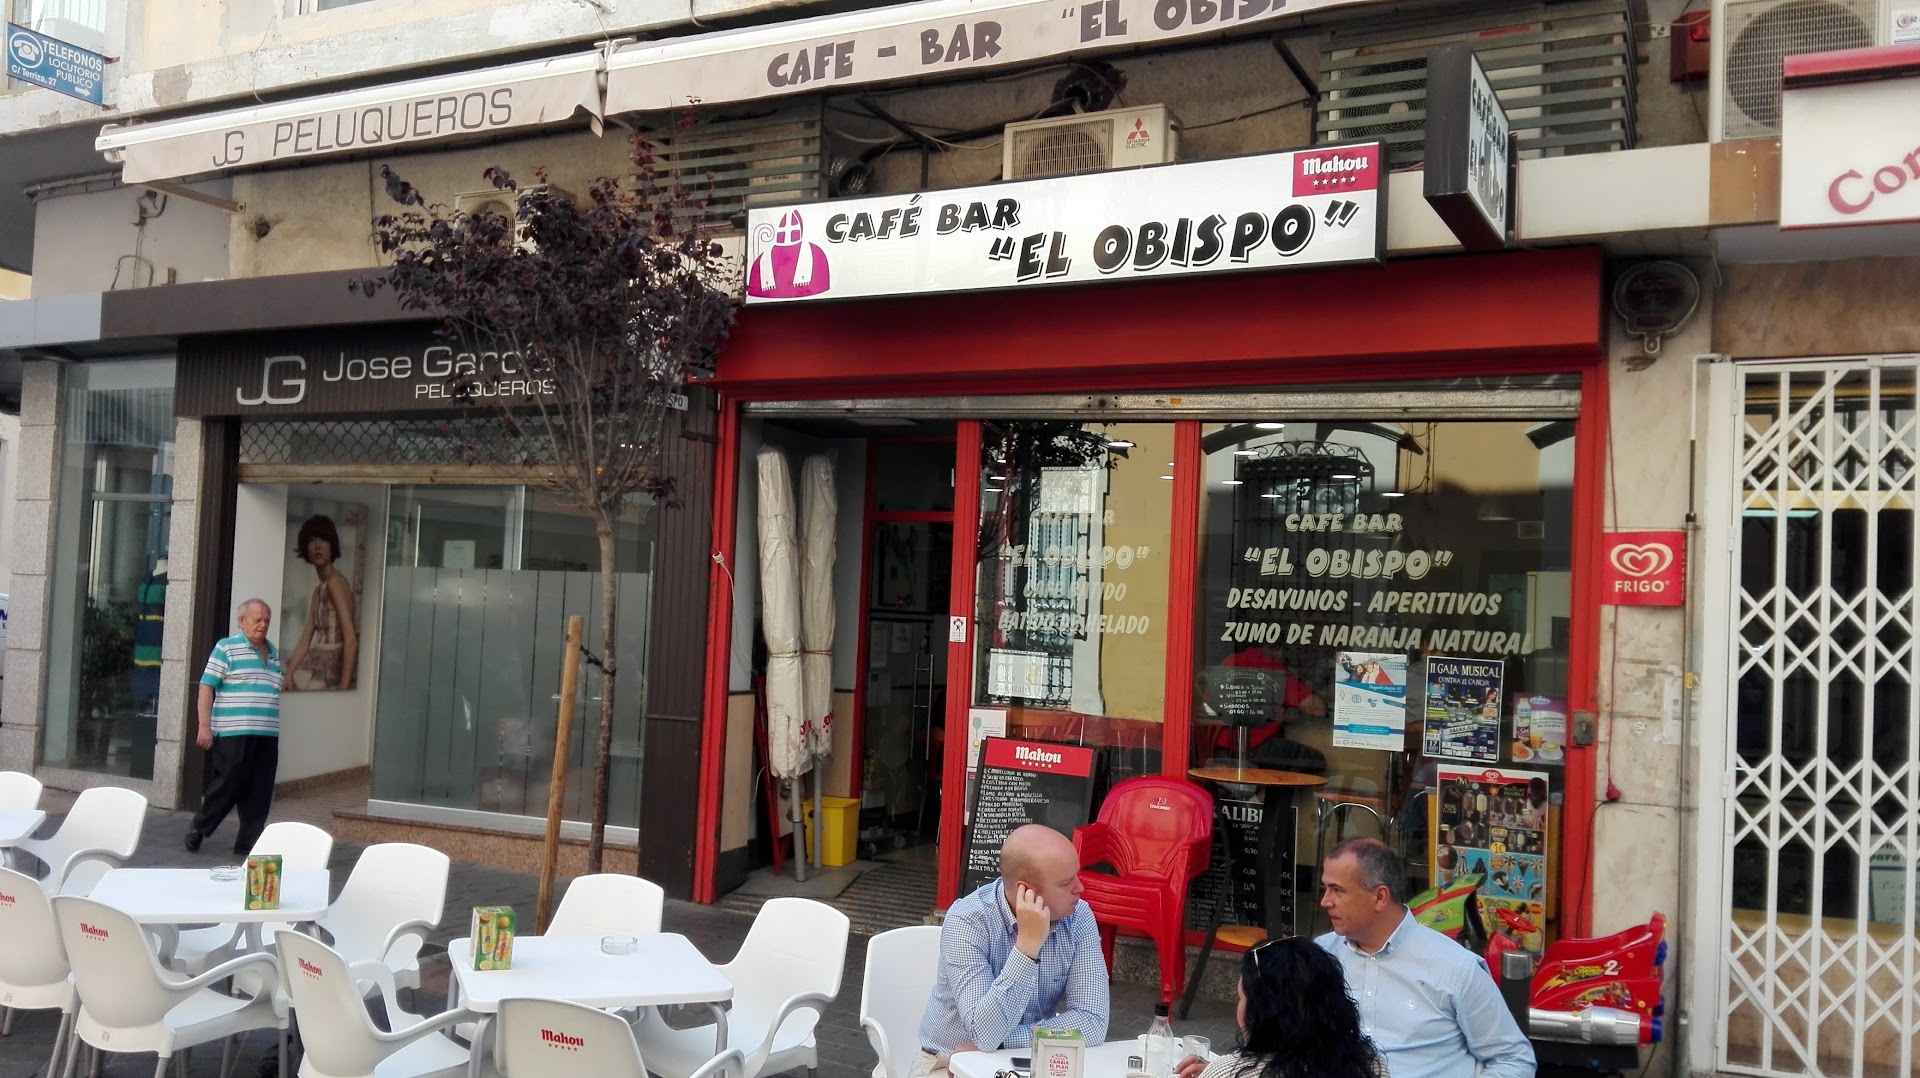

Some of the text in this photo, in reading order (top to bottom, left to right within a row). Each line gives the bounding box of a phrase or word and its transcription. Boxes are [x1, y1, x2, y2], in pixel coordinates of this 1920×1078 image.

[42, 40, 102, 71] TELEFONOS
[766, 41, 854, 89] CAFE
[920, 20, 1002, 66] BAR
[12, 65, 57, 86] C/ Terriza, 27
[49, 57, 100, 81] LOCUTORIO
[56, 69, 93, 89] PUBLICO
[212, 87, 513, 168] JG PELUQUEROS
[1302, 154, 1369, 176] Mahou
[825, 195, 1021, 244] CAFÉ BAR
[1093, 199, 1360, 274] OBISPO"
[236, 355, 306, 406] JG
[322, 351, 412, 383] Jose
[1284, 507, 1404, 533] CAFÉ BAR
[1305, 548, 1454, 580] OBISPO"
[1615, 580, 1665, 593] FRIGO
[1226, 588, 1349, 611] DESAYUNOS
[1367, 590, 1502, 616] APERITIVOS
[1085, 615, 1150, 635] HELADO
[1220, 620, 1534, 655] ZUMO DE NARANJA NATURAL
[1438, 676, 1461, 685] CONTRA
[1461, 664, 1500, 678] MUSICAL
[1015, 745, 1062, 764] Mahou
[80, 922, 109, 938] Mahou
[297, 956, 323, 976] Mahou
[1604, 960, 1620, 976] 2
[541, 1029, 584, 1046] Mahou
